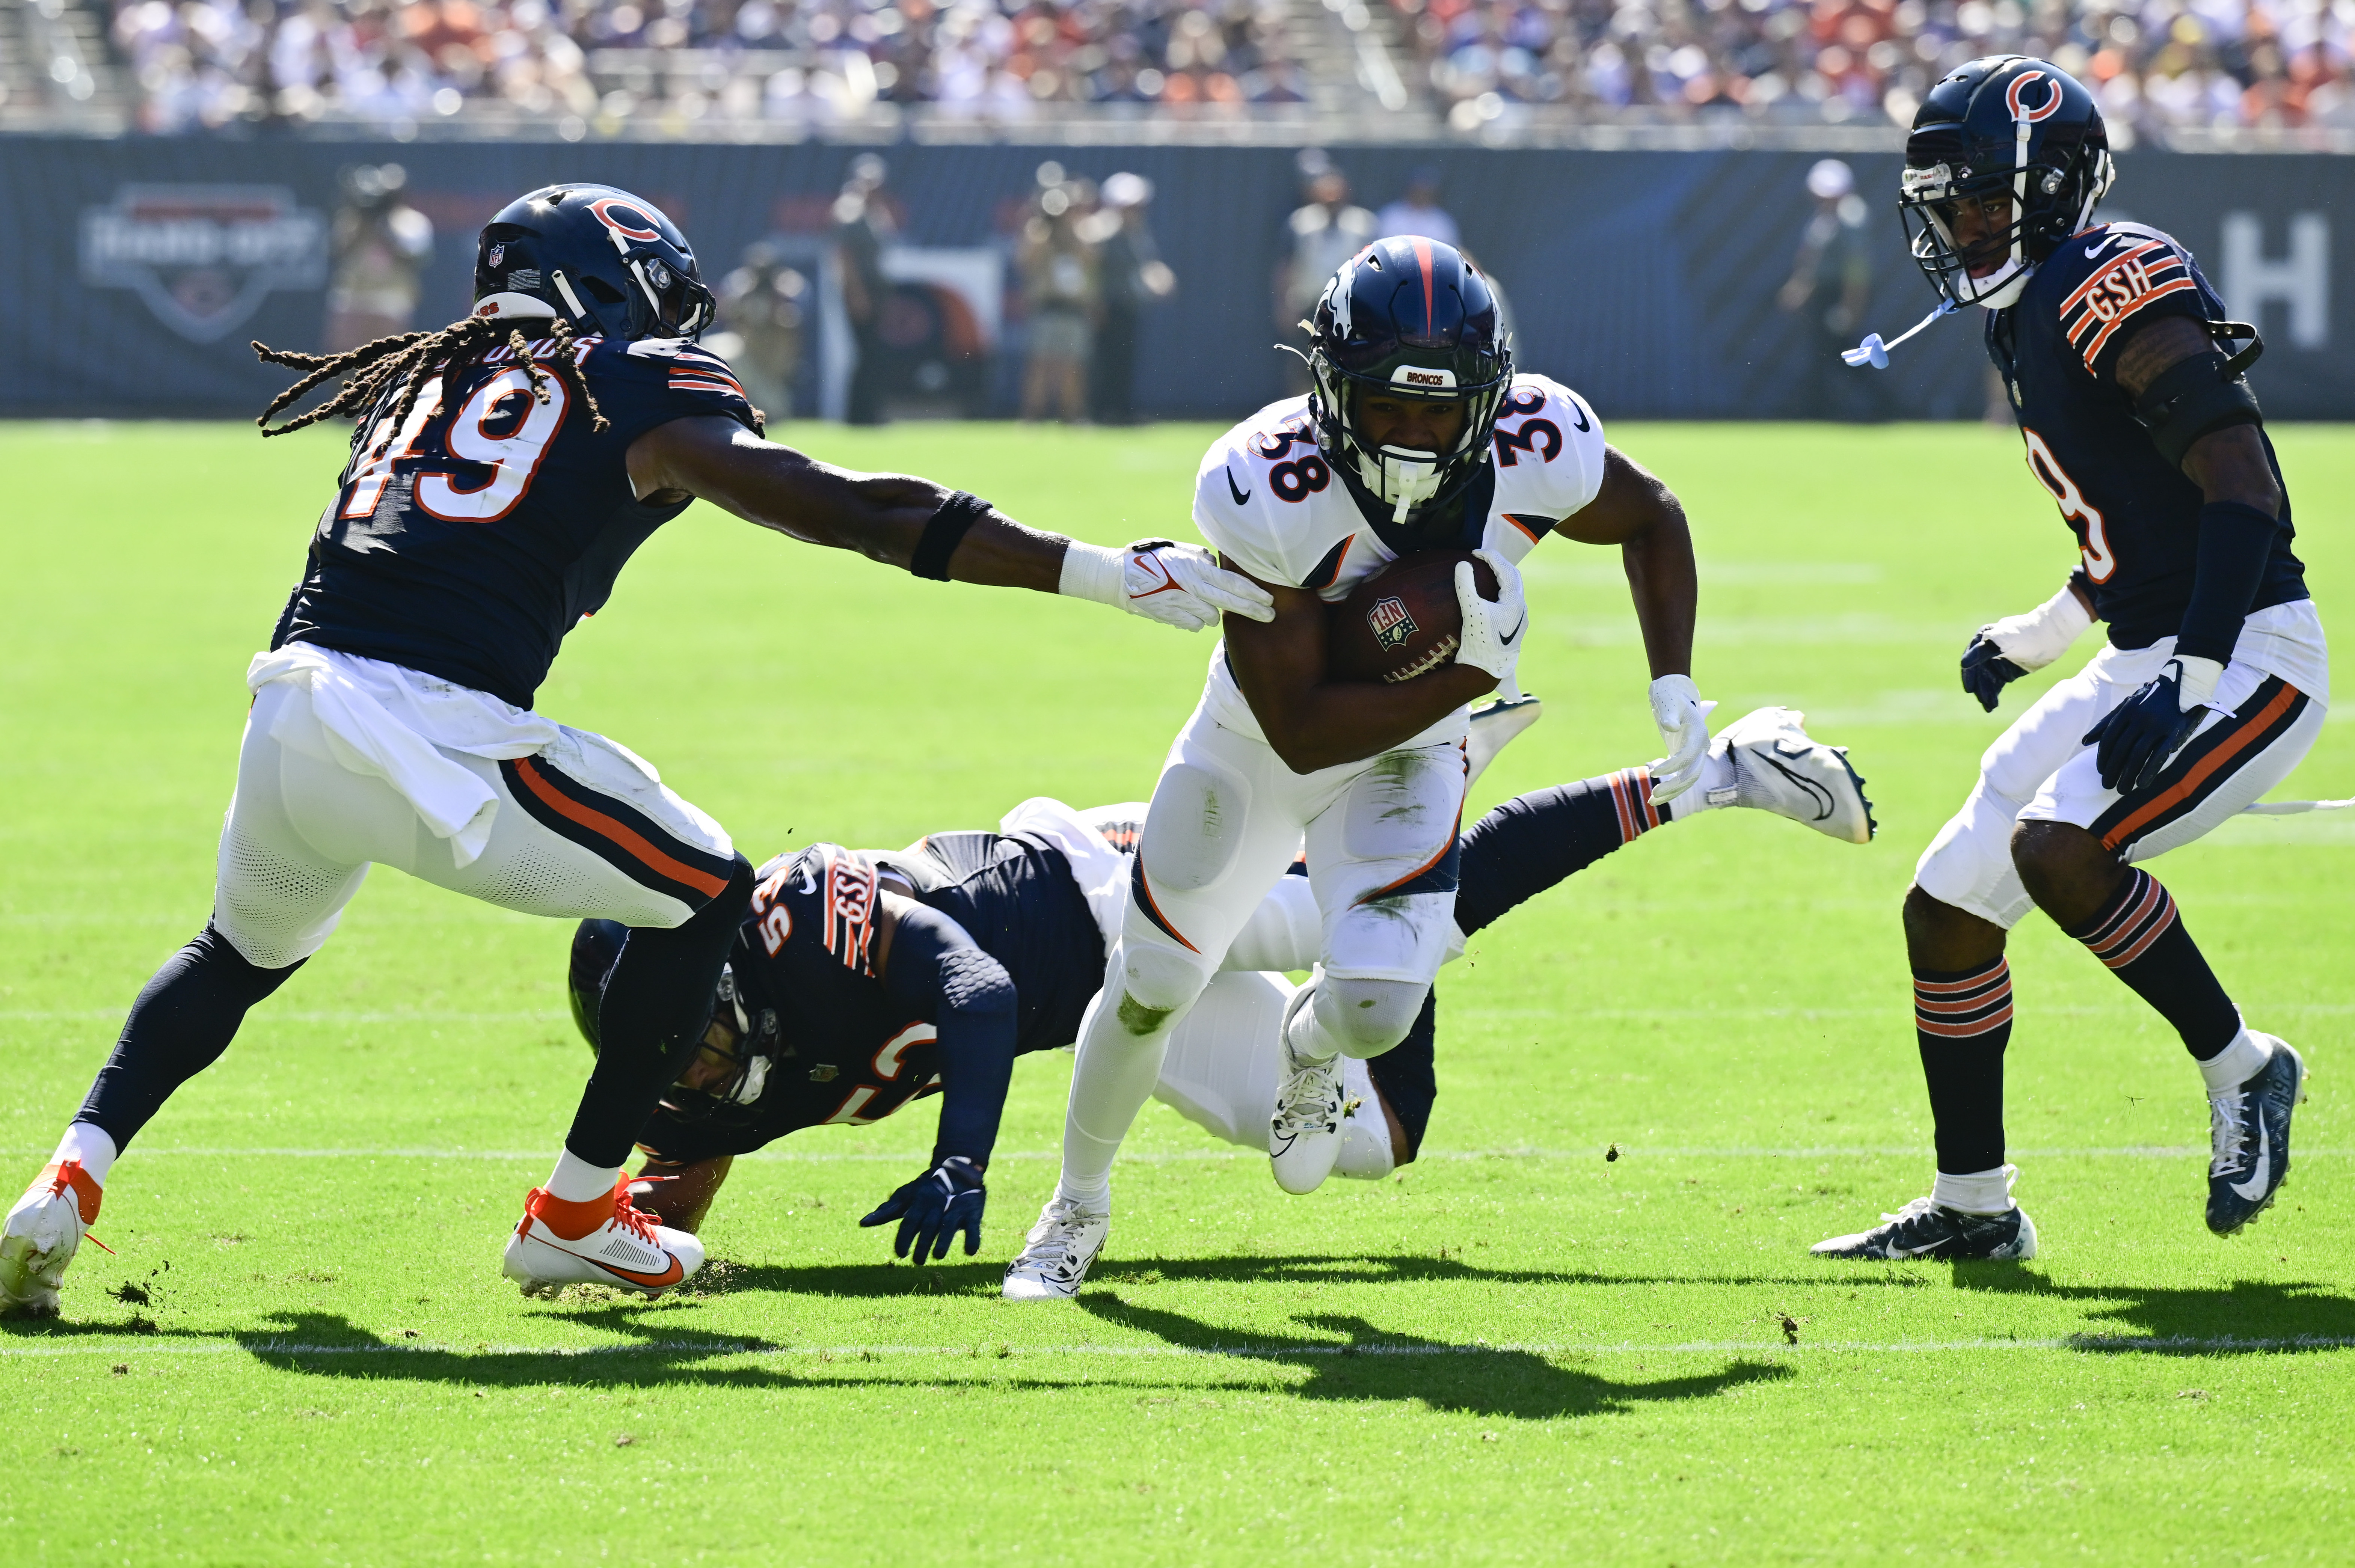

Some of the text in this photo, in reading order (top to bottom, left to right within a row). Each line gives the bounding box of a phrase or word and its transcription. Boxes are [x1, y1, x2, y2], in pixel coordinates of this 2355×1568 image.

[491, 254, 501, 264] NFL
[2085, 256, 2153, 323] GSH
[1407, 371, 1443, 386] BRONCOS
[339, 362, 570, 523] 49
[1246, 417, 1330, 503] 38
[1493, 386, 1563, 468] 38
[2023, 427, 2117, 585] 9
[1371, 602, 1405, 631] NFL
[835, 857, 870, 925] GSH
